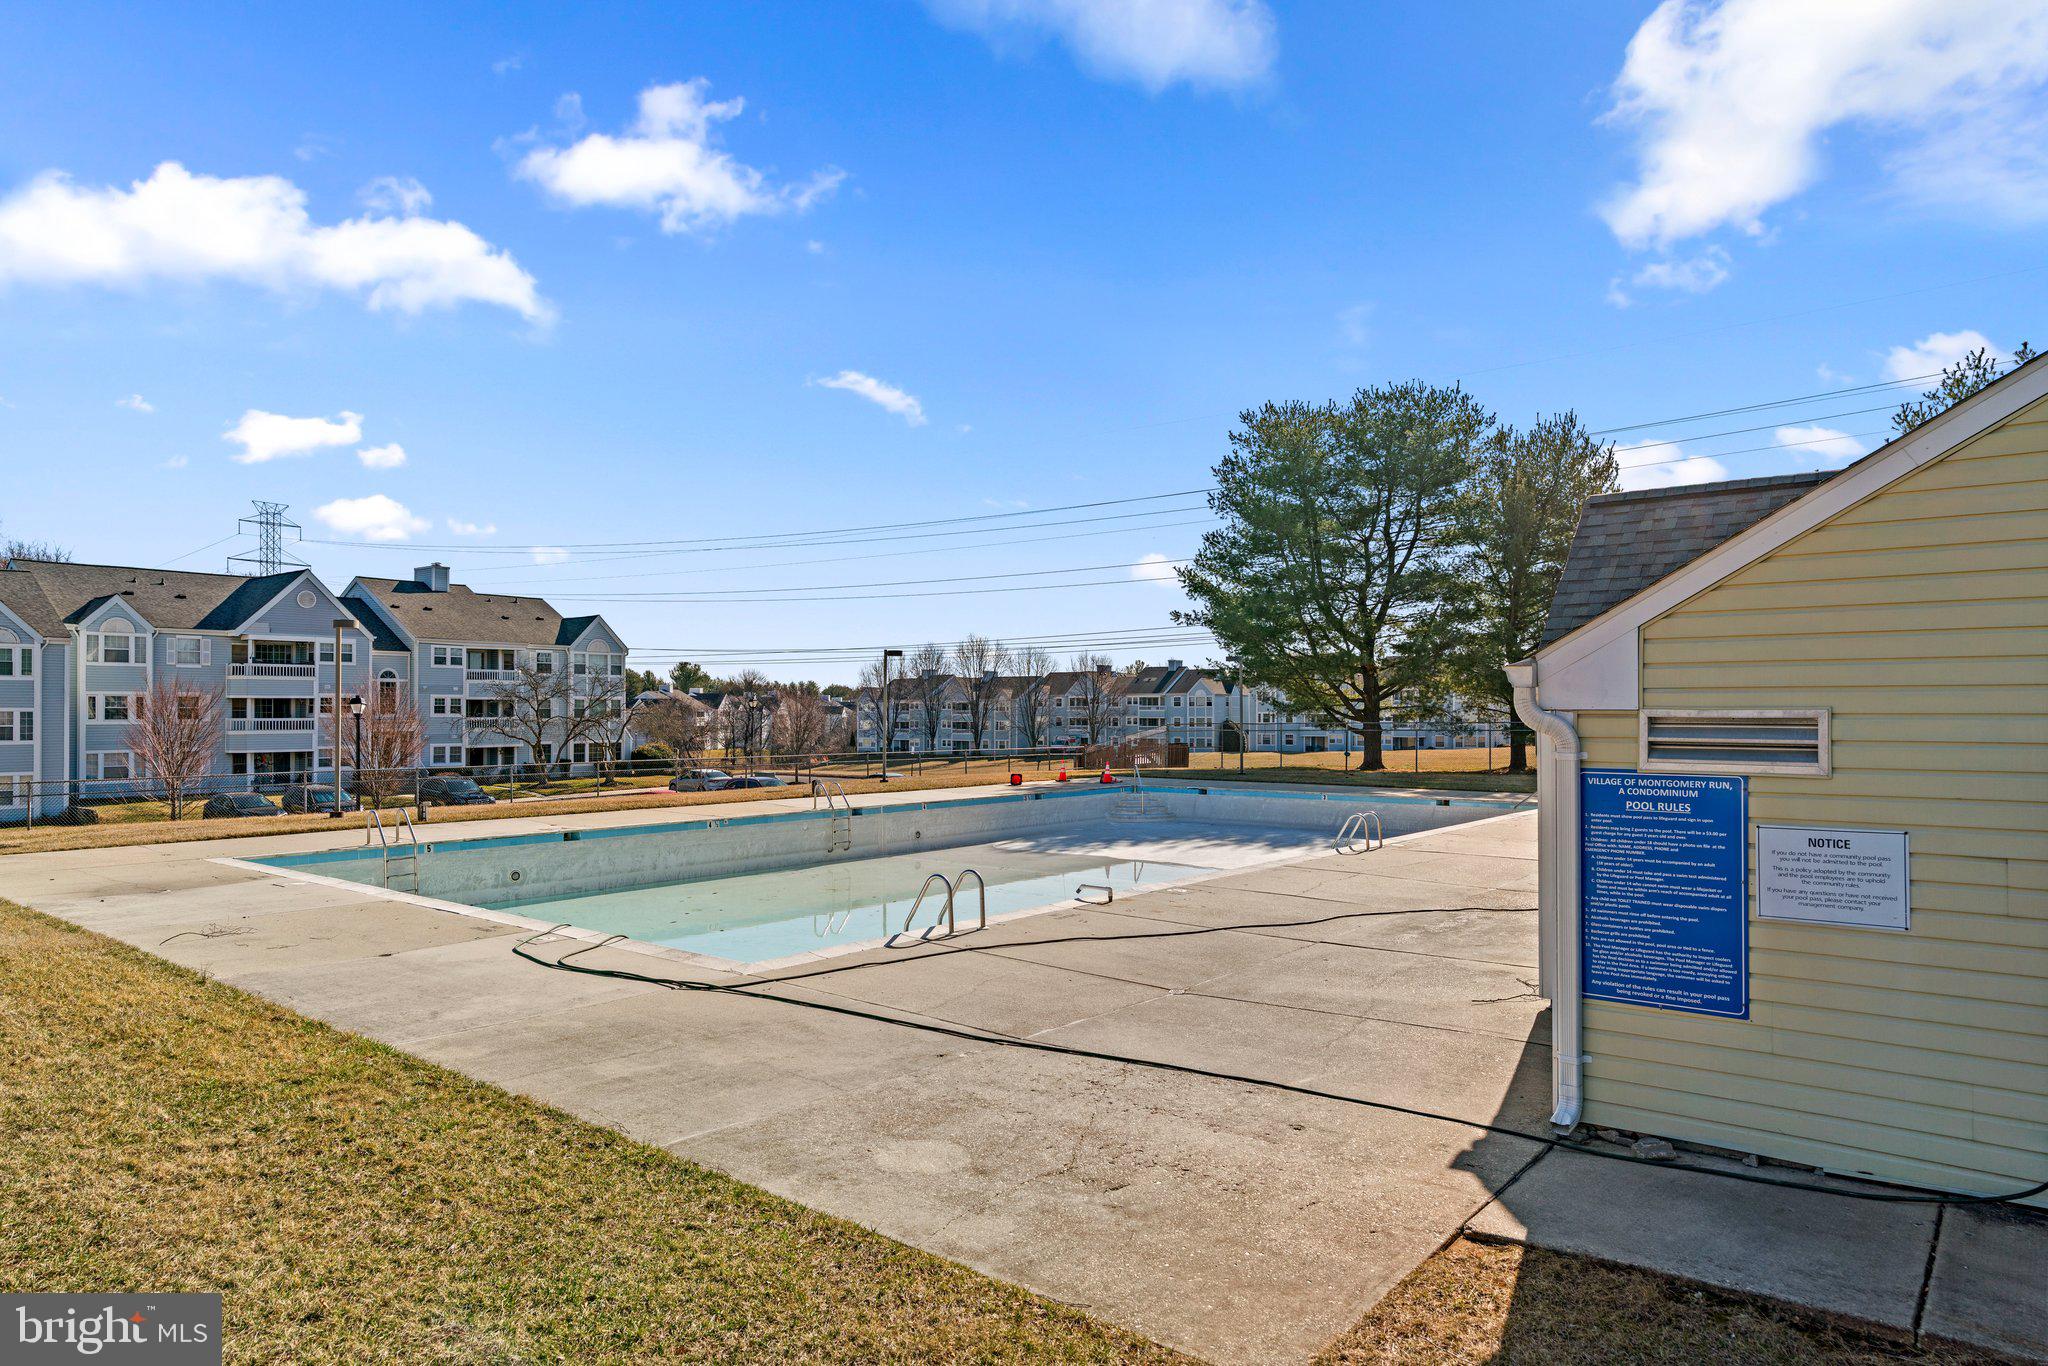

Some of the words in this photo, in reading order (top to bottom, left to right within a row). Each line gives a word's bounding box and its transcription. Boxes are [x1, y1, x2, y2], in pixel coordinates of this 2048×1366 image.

[1588, 778, 1621, 786] VILLAGE
[1624, 778, 1636, 786] OF
[1638, 779, 1706, 789] MONTGOMERY
[1709, 781, 1732, 791] RUN,
[1618, 787, 1625, 795] A
[1627, 788, 1698, 798] CONDOMINIUM
[1626, 800, 1655, 811] POOL
[1658, 802, 1691, 813] RULES
[1808, 838, 1851, 849] NOTICE
[1814, 874, 1846, 882] employees
[1812, 881, 1844, 889] community
[1602, 980, 1625, 988] violation
[1617, 988, 1632, 996] being
